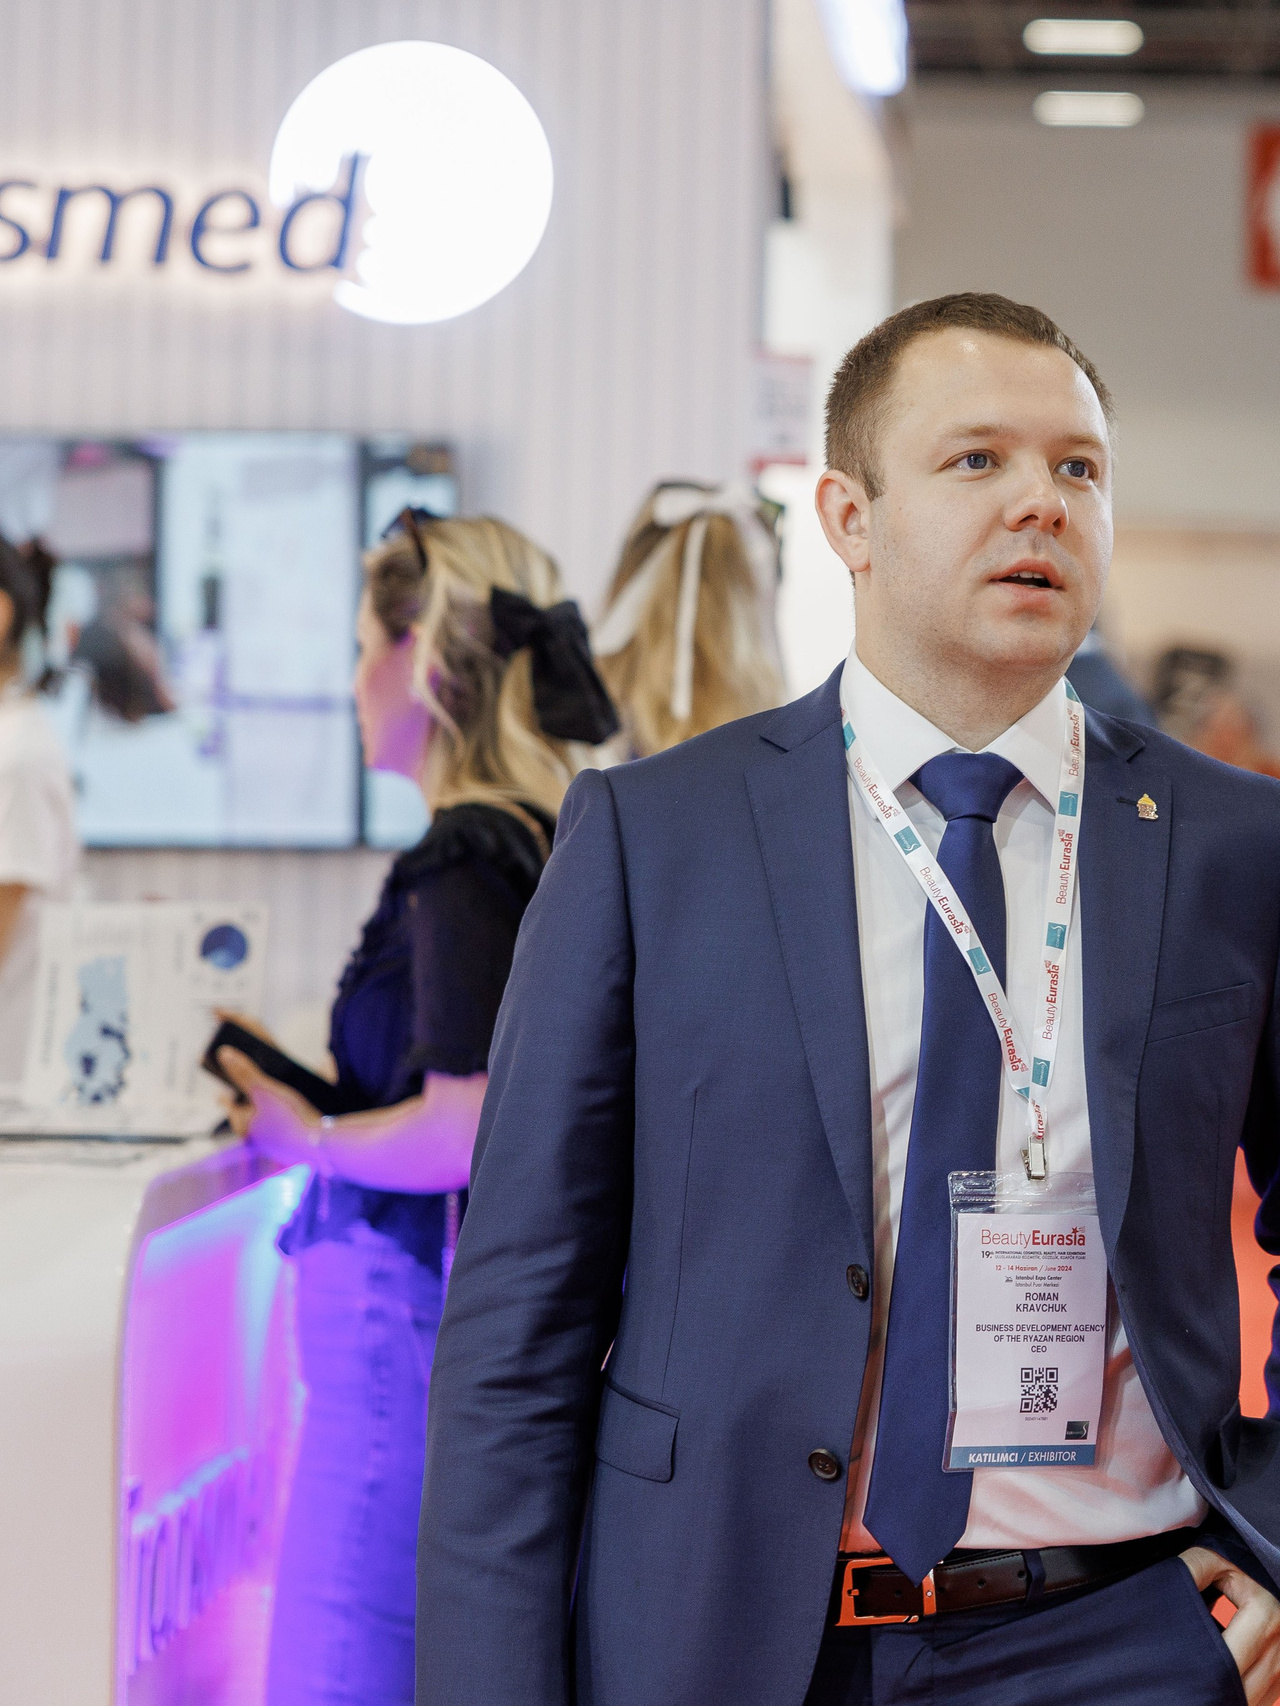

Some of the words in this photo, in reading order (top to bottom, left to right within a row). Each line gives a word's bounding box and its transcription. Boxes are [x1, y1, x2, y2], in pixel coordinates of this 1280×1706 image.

[854, 757, 893, 820] BeautyEurasia
[1056, 833, 1074, 905] BeautyEurasia
[920, 866, 965, 935] BeautyEurasia
[1042, 964, 1060, 1040] BeautyEurasia
[987, 992, 1021, 1072] BeautyEurasia
[981, 1227, 1086, 1249] BeautyEurasia
[1024, 1292, 1059, 1301] ROMAN
[1015, 1303, 1067, 1313] KRAVCHUK
[975, 1324, 1014, 1332] BUSINESS
[1015, 1324, 1072, 1332] DEVELOPMENT
[1073, 1324, 1105, 1332] AGENCY
[993, 1335, 1004, 1343] OF
[1055, 1335, 1085, 1343] REGION
[1030, 1345, 1047, 1353] CEO
[968, 1452, 1018, 1463] KATILIMCI
[1028, 1451, 1077, 1462] EXHIBITOR
